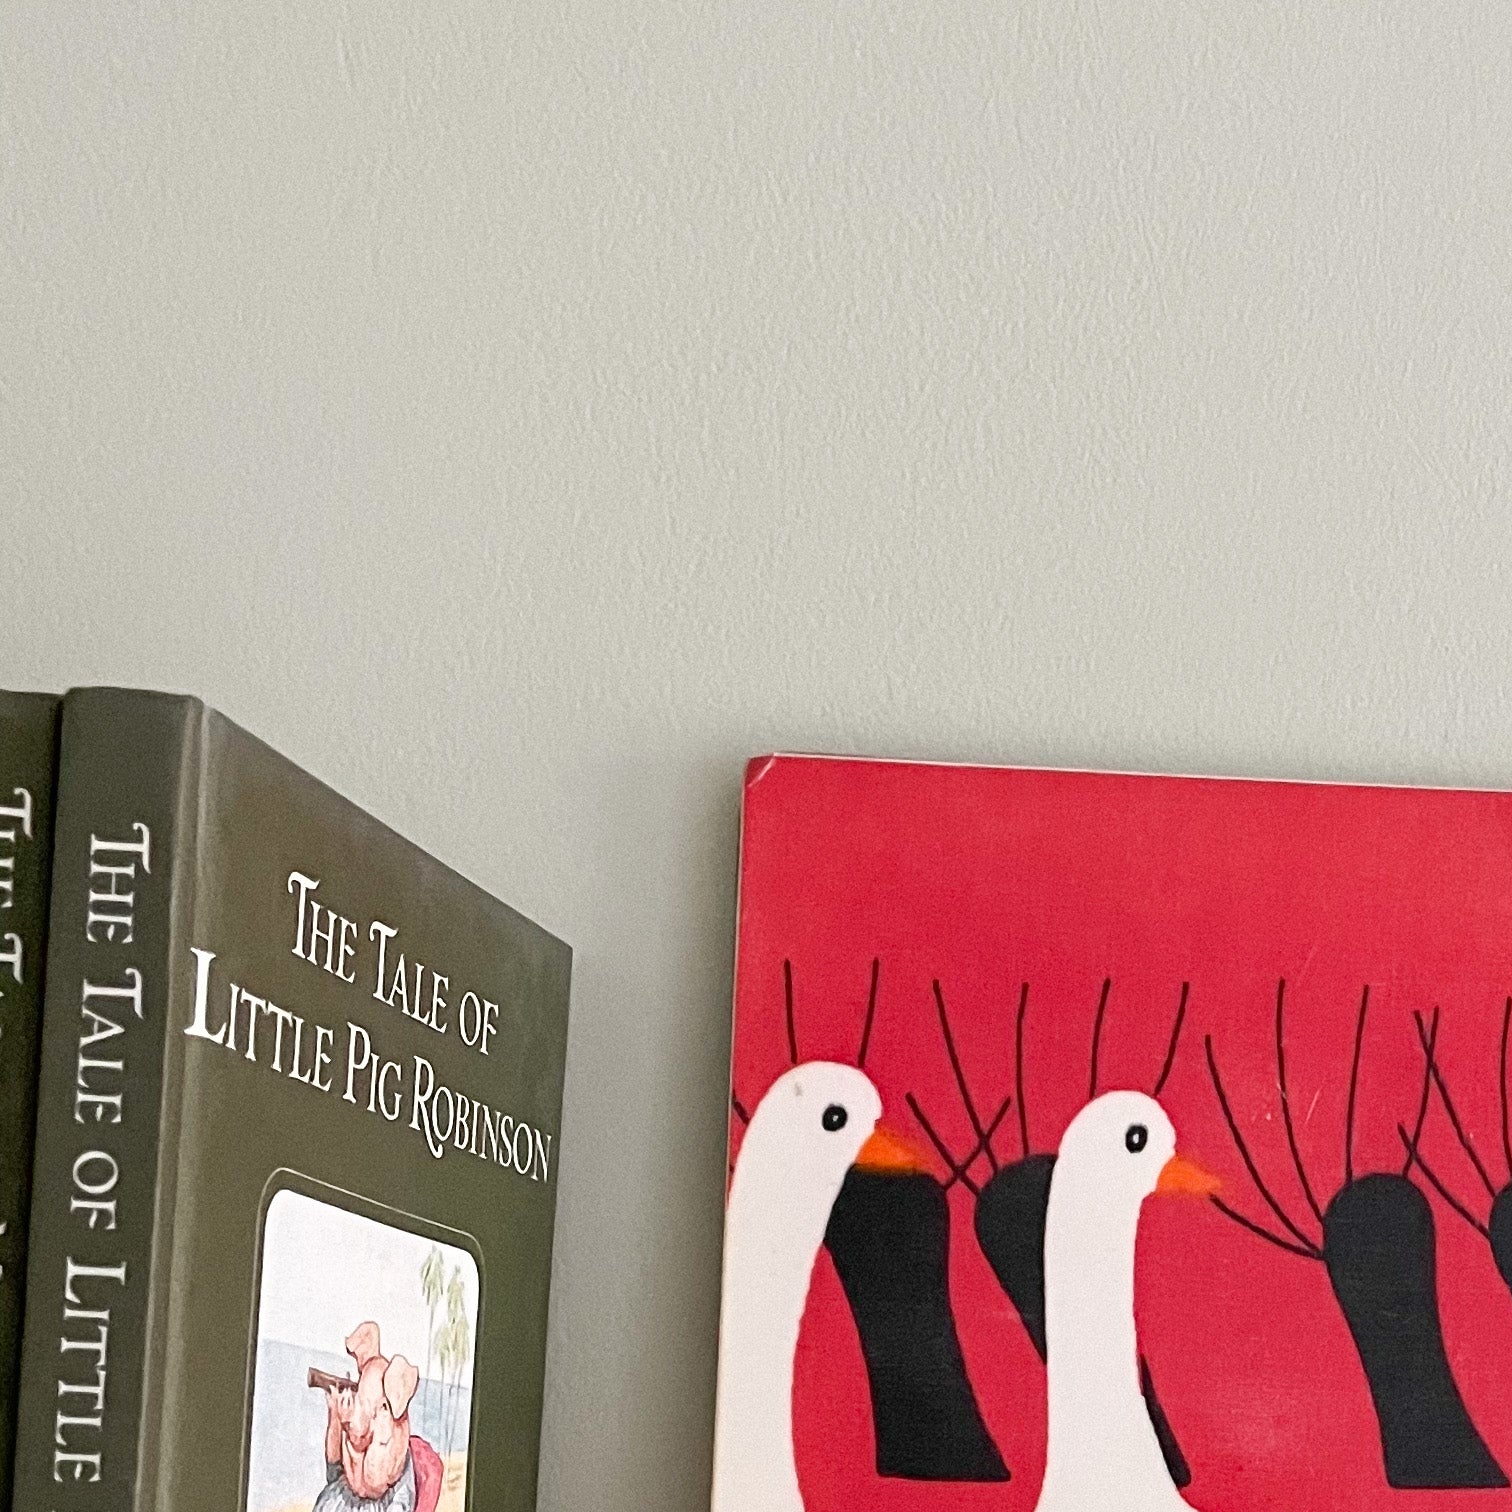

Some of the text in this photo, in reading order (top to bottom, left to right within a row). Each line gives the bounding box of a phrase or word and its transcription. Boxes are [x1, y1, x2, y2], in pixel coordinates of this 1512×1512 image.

[87, 822, 152, 943] THE
[287, 871, 500, 1056] THE TALE OF
[74, 967, 144, 1124] TALE
[184, 946, 553, 1183] LITTLE PIG ROBINSON
[70, 1150, 119, 1230] OF
[53, 1256, 127, 1484] LITTLE
